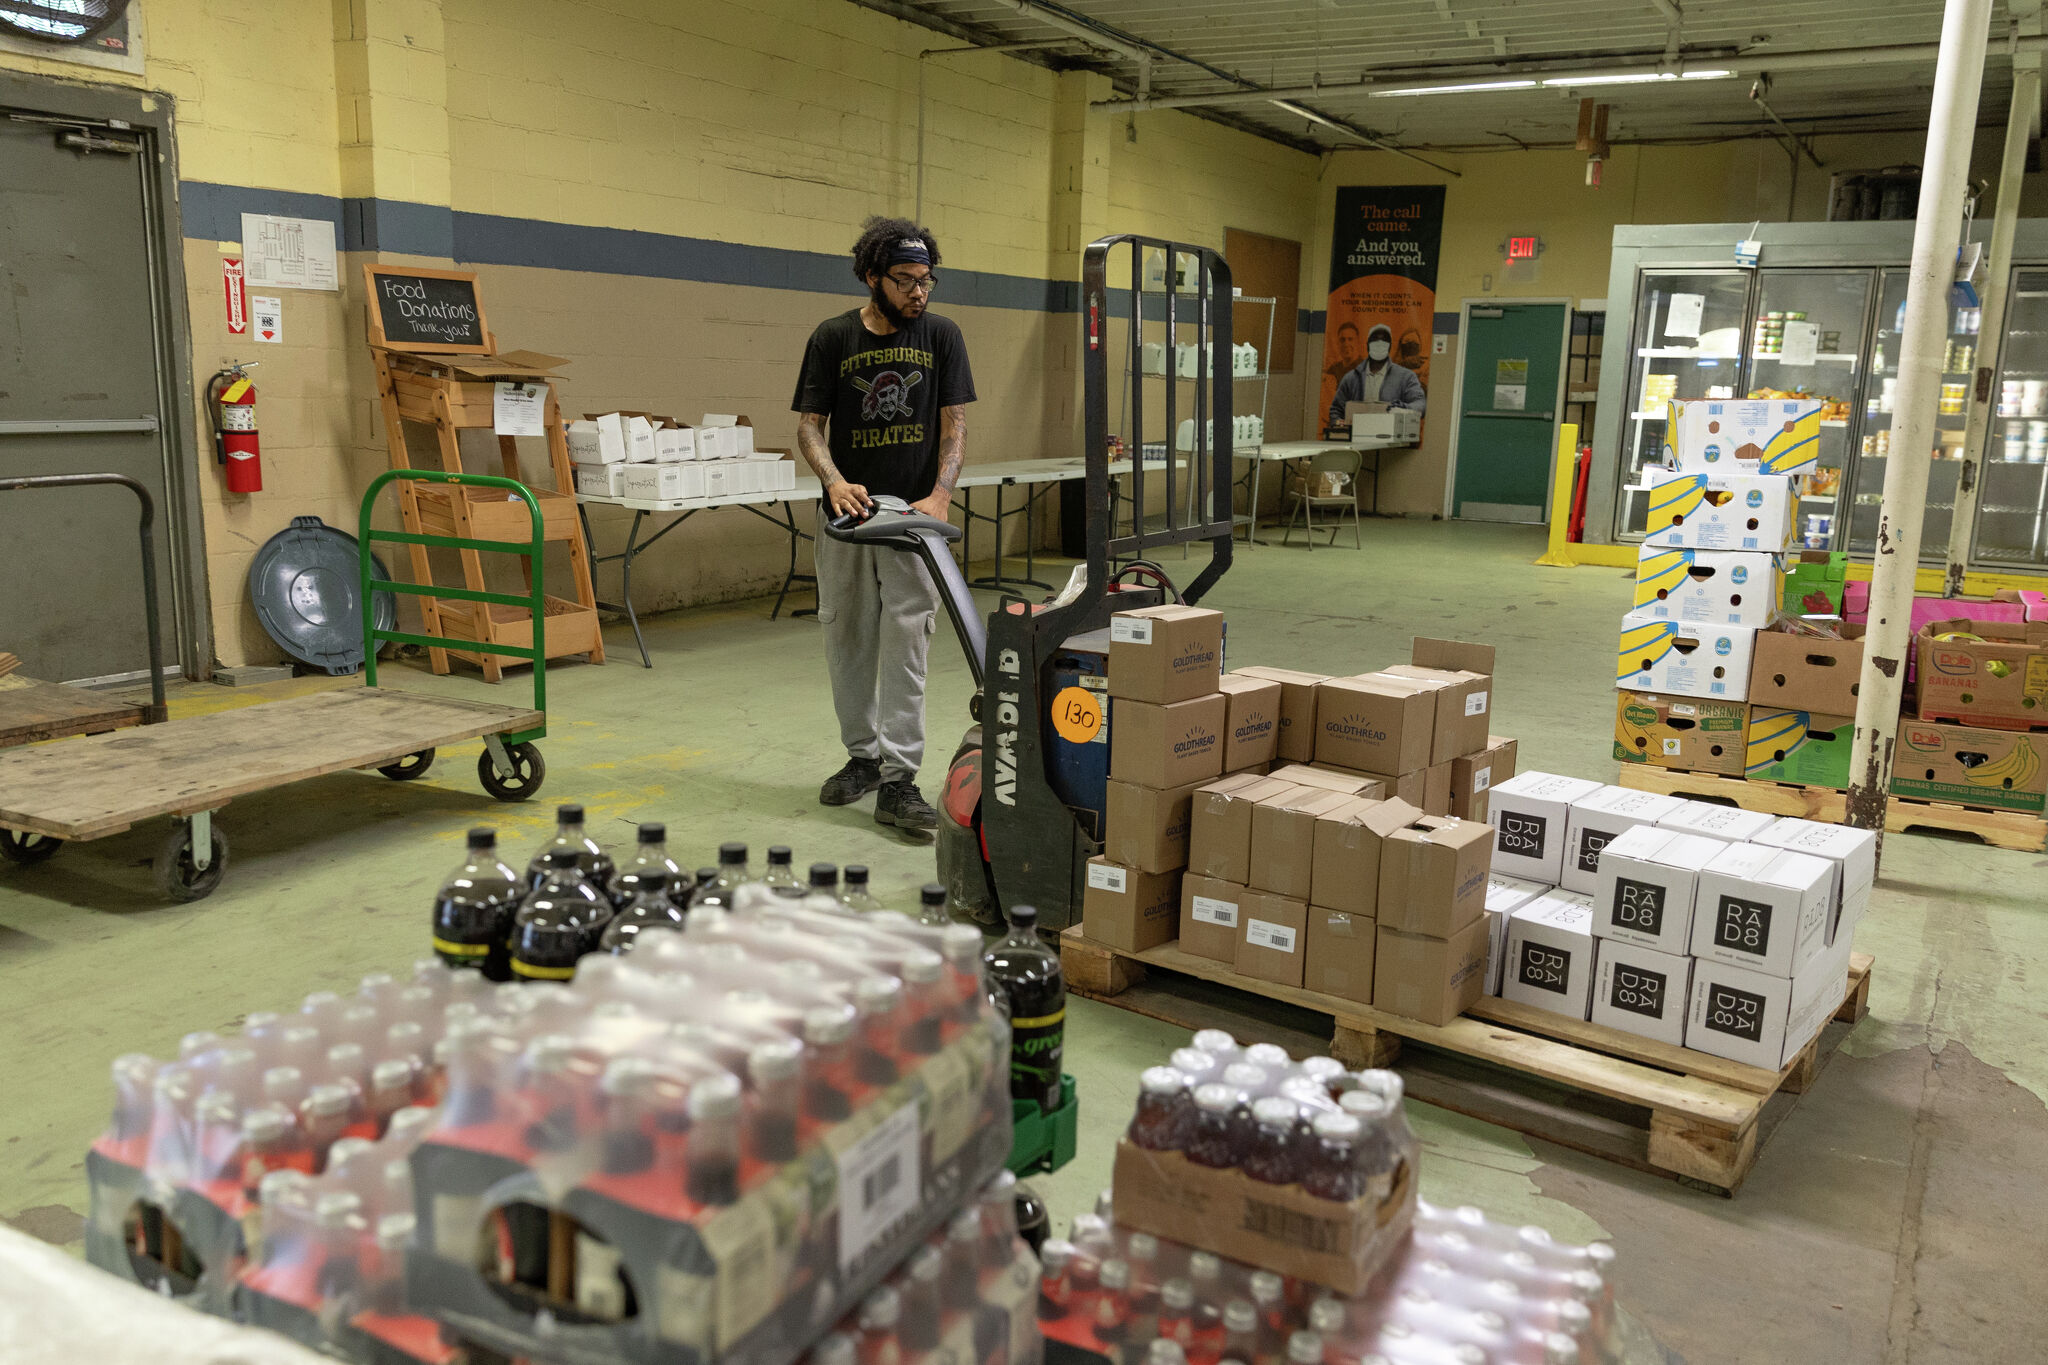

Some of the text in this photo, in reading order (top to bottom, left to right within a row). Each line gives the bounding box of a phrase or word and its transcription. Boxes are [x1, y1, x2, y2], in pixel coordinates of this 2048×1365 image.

[1360, 203, 1421, 219] The call
[1367, 221, 1412, 232] came.
[1355, 238, 1419, 255] And you
[1509, 237, 1535, 257] EXIT
[1346, 251, 1426, 266] answered.
[226, 268, 241, 276] FIRE
[384, 279, 426, 299] Food
[397, 299, 476, 321] Donations
[840, 347, 933, 378] PITTSBURGH
[851, 423, 924, 449] PIRATES
[1173, 651, 1214, 668] GOLDTHREAD
[1940, 653, 1972, 666] Dole
[1928, 676, 1978, 689] BANANAS
[1065, 700, 1095, 728] 130
[1698, 704, 1745, 718] ORGANIC
[1235, 720, 1272, 738] GOLDTHREAD
[1326, 721, 1386, 740] GOLDTHREAD
[1911, 731, 1941, 744] Dole
[1173, 735, 1215, 753] GOLDTHREAD
[1896, 779, 2041, 802] BANANAS CERTIFIED ORGANIC BANANAS
[1620, 903, 1654, 926] D8
[1723, 922, 1759, 946] D8
